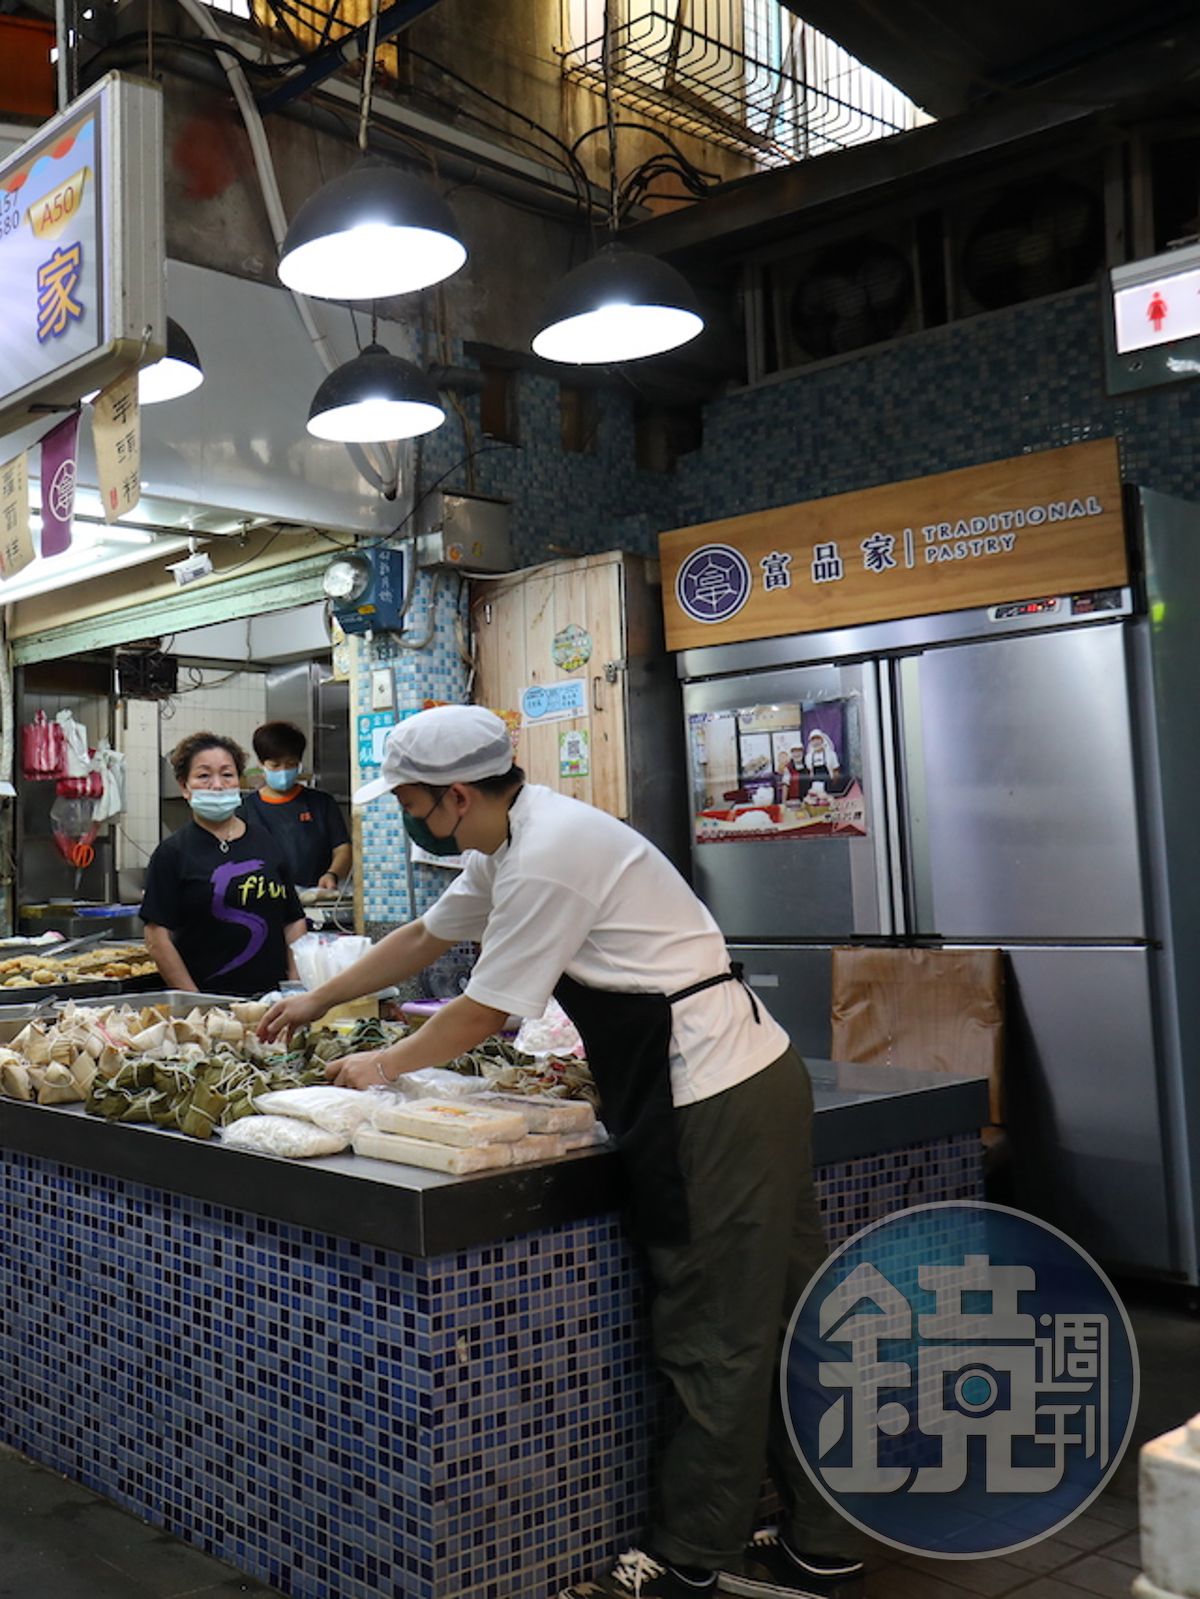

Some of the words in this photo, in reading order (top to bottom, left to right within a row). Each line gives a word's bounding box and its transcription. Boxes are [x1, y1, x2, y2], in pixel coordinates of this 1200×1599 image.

[40, 186, 75, 231] A50
[922, 497, 1102, 543] TRADITIONAL
[760, 533, 896, 591] 富品家
[926, 534, 1015, 564] PASTRY
